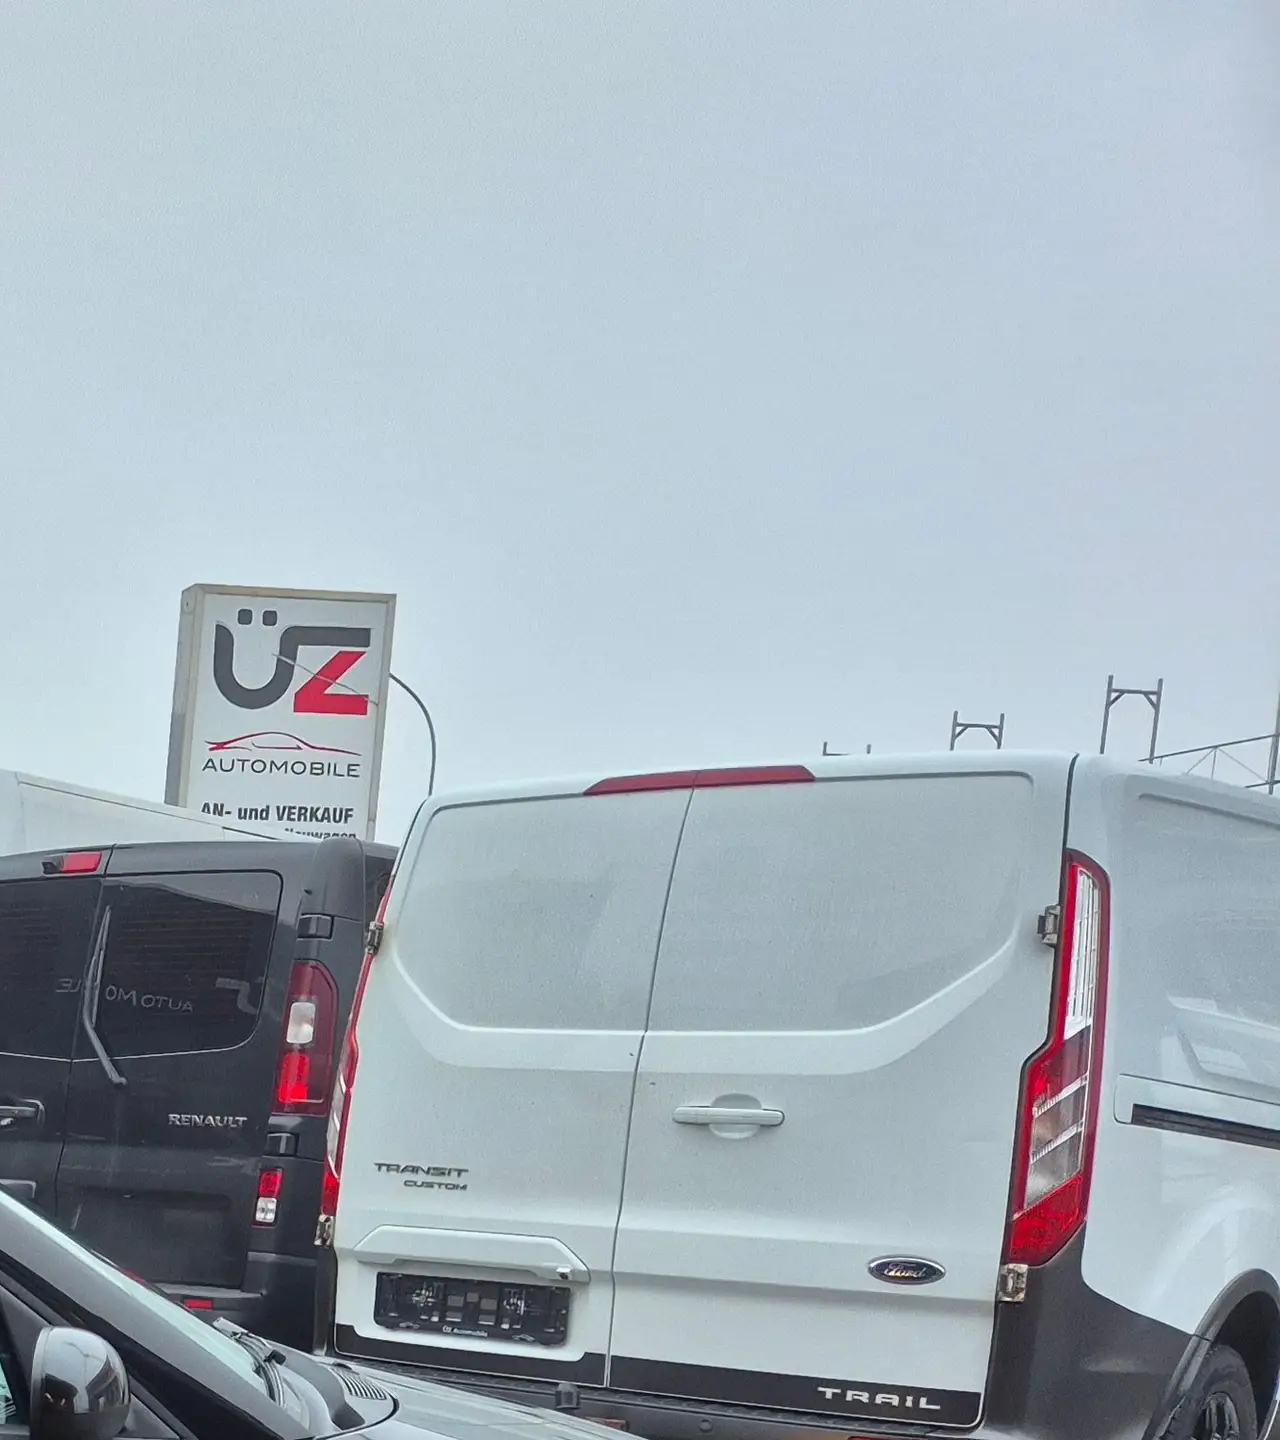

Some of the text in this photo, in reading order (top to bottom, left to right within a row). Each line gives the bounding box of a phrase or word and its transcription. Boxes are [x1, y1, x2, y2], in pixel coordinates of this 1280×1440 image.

[202, 757, 361, 778] AUTOMOBILE
[237, 804, 270, 822] und
[276, 805, 354, 825] VERKAUF
[168, 1113, 248, 1128] RENAULT
[374, 1162, 469, 1178] TRANSIT
[403, 1180, 468, 1191] CUSTOM
[883, 1262, 928, 1278] Ford
[817, 1386, 941, 1410] TRAIL
